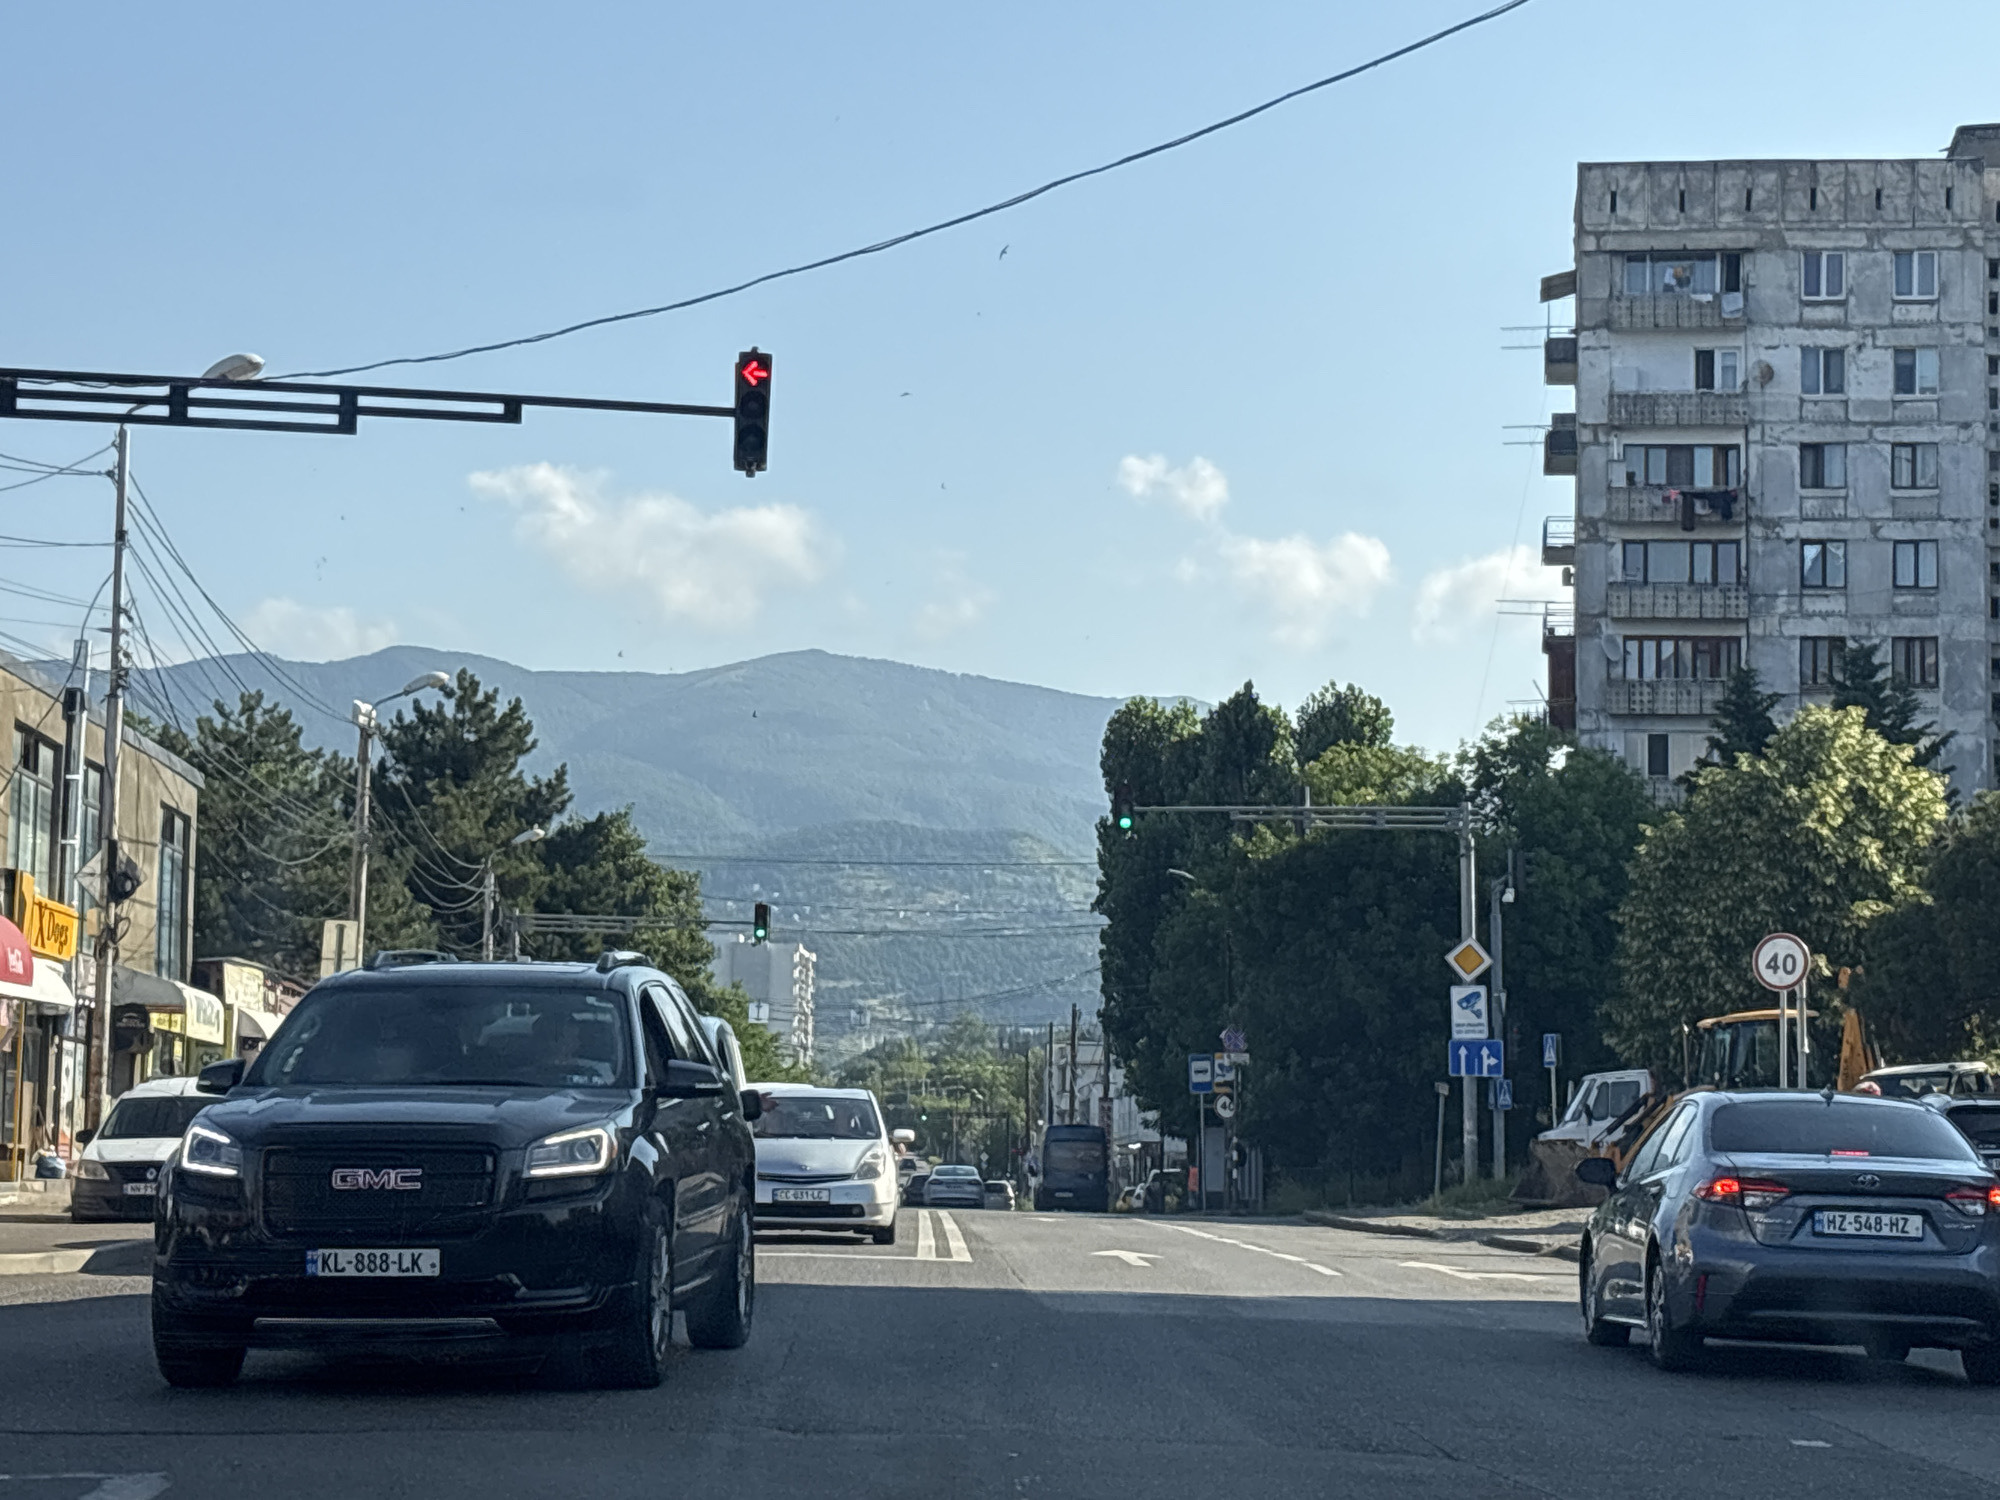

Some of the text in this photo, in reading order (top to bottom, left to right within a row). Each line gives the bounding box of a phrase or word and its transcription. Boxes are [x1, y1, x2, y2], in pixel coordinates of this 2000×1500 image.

[34, 901, 69, 955] X Dogs
[1765, 951, 1797, 976] 40
[332, 1168, 423, 1190] GMC
[1826, 1215, 1910, 1234] HZ-548-HZ
[320, 1252, 423, 1274] KL-888-LK
